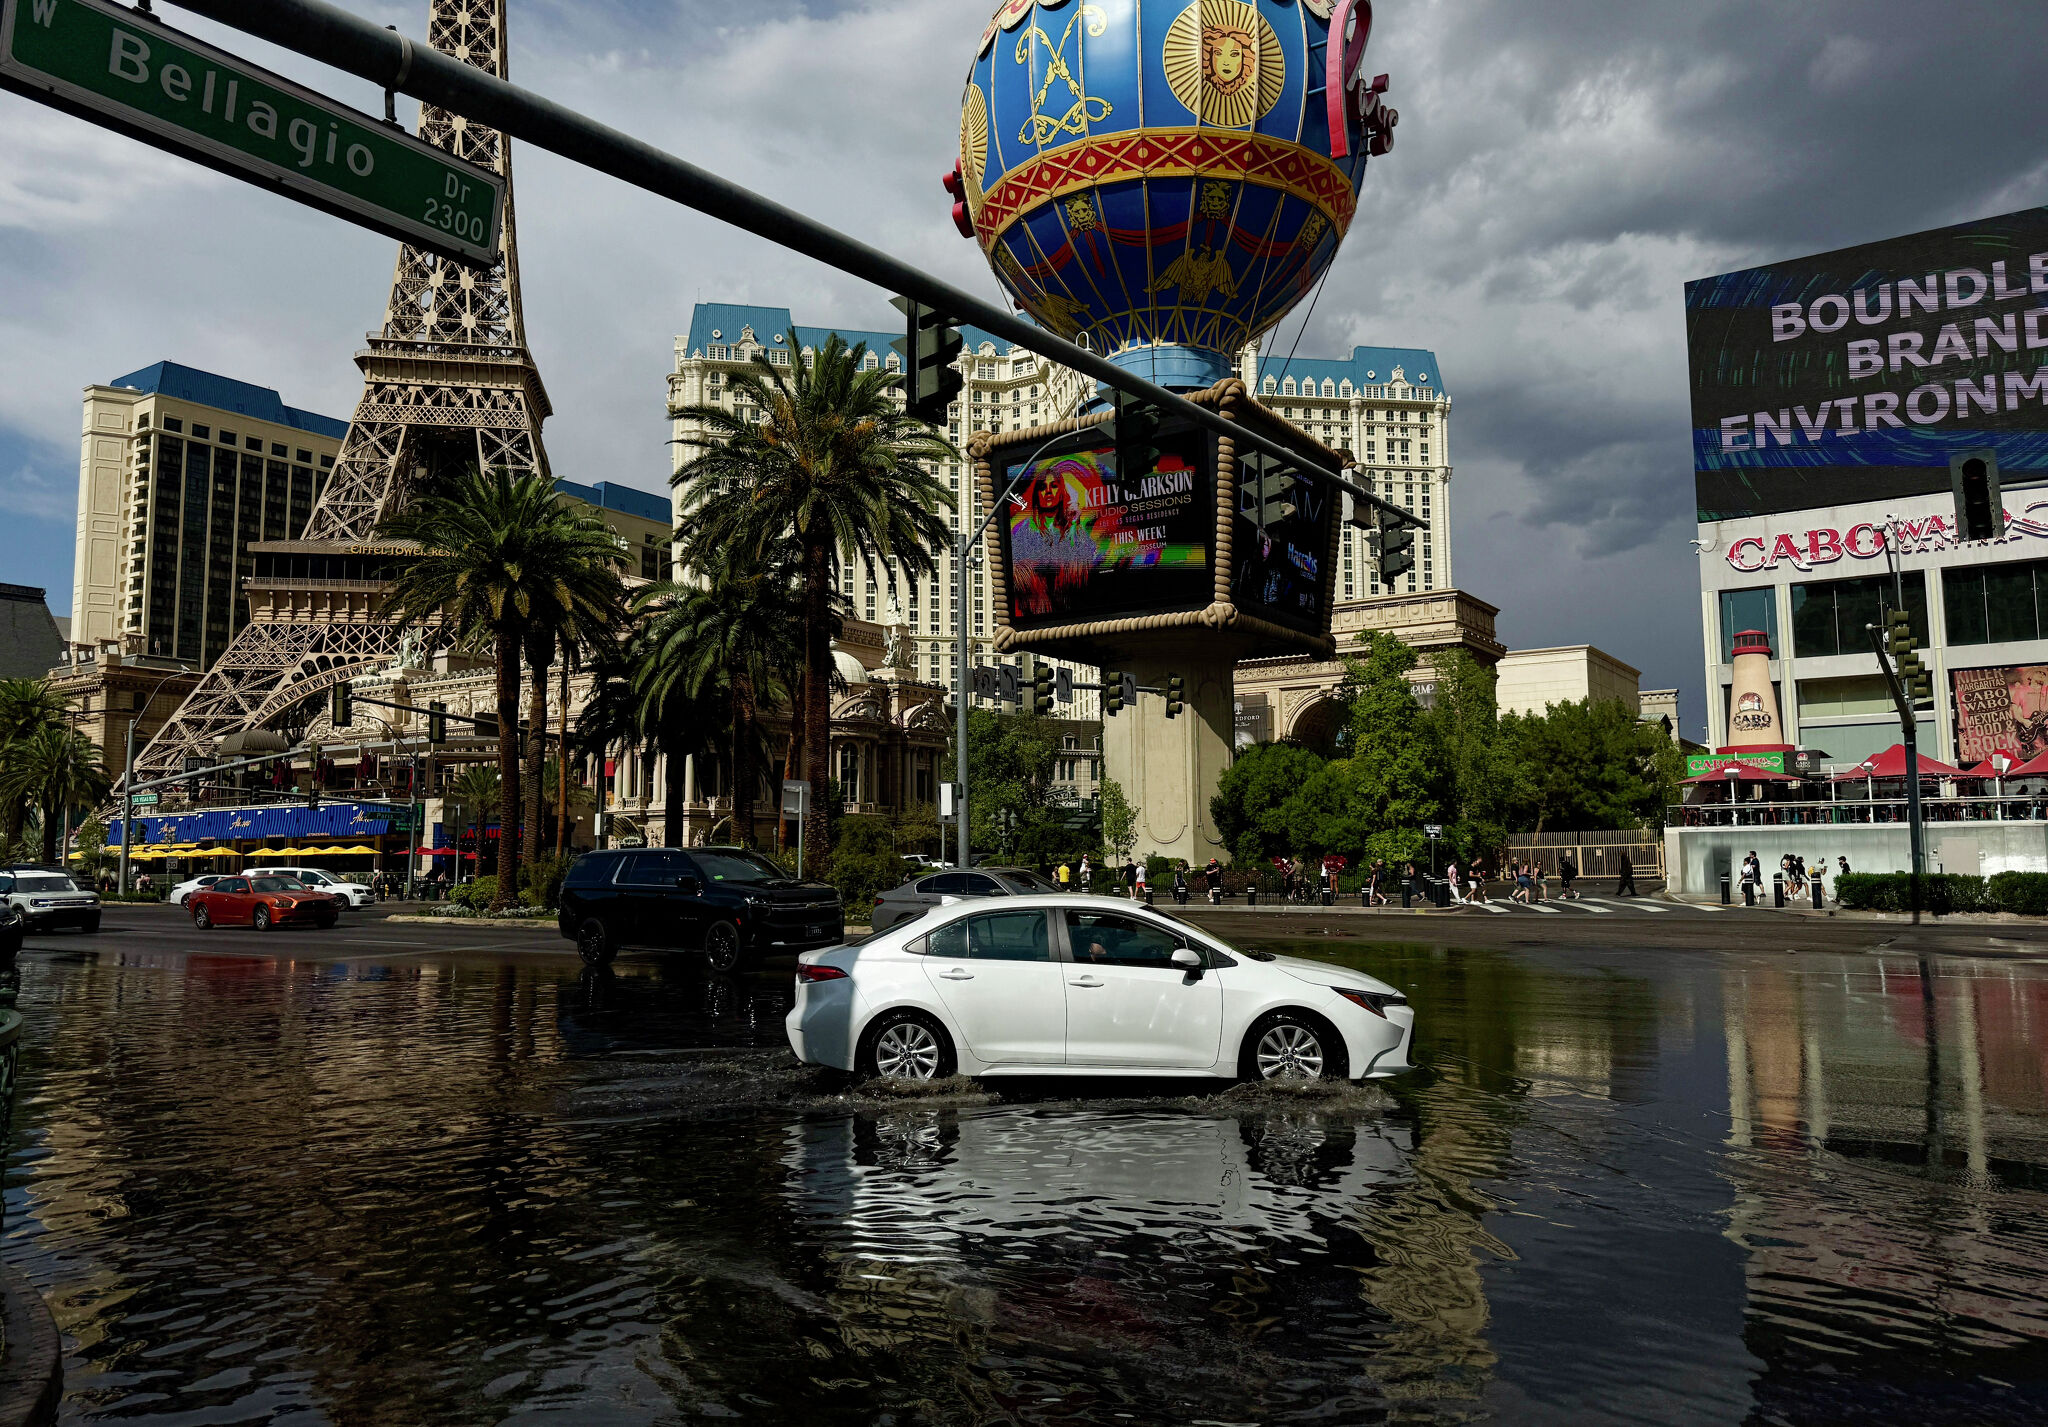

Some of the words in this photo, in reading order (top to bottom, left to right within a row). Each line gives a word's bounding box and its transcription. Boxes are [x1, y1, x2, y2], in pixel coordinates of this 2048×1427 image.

[32, 0, 56, 29] W
[108, 28, 375, 178] Bellagio
[444, 171, 471, 204] Dr
[423, 199, 484, 242] 2300
[1771, 252, 2048, 343] BOUNDLE
[1847, 306, 2048, 381] BRAND
[1720, 365, 2048, 454] ENVIRONM
[1084, 484, 1120, 509] KELLY
[1131, 494, 1192, 513] SESSIONS
[1125, 515, 1143, 523] VEGAS
[1146, 508, 1180, 520] RESIDENCY
[1114, 530, 1134, 545] THIS
[1137, 525, 1167, 542] WEEK!
[350, 544, 387, 555] EIFFEL
[1725, 521, 1887, 571] CABO
[1956, 669, 2004, 684] KILLER
[1958, 678, 2006, 692] MARGARITAS
[1961, 688, 2007, 703] CABO
[1962, 698, 2009, 712] WABO
[1733, 713, 1772, 725] CABO
[1965, 710, 2013, 727] MEXICAN
[1967, 722, 2002, 738] FOOD
[2006, 719, 2017, 732] &
[1968, 732, 2020, 757] ROCK
[1690, 758, 1736, 771] CABO
